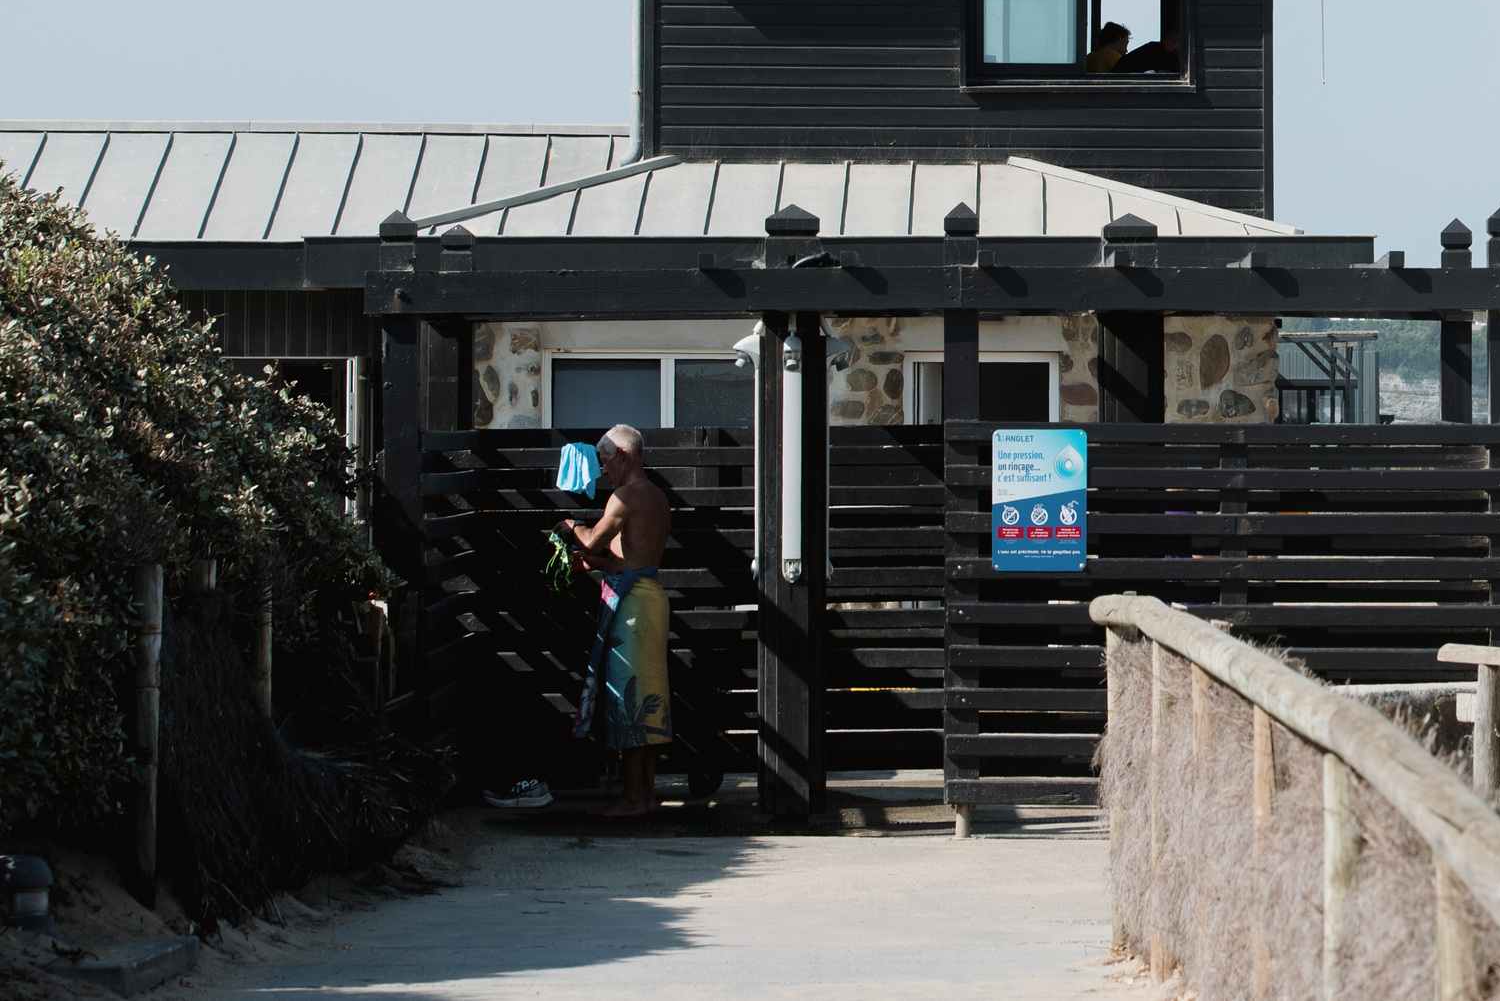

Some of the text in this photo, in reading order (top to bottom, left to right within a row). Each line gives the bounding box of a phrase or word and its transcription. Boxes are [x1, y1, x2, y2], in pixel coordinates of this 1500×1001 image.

[998, 450, 1045, 461] Une pression,
[1008, 462, 1041, 473] rinçage...
[998, 472, 1015, 482] c'est
[1017, 473, 1047, 482] suffisant
